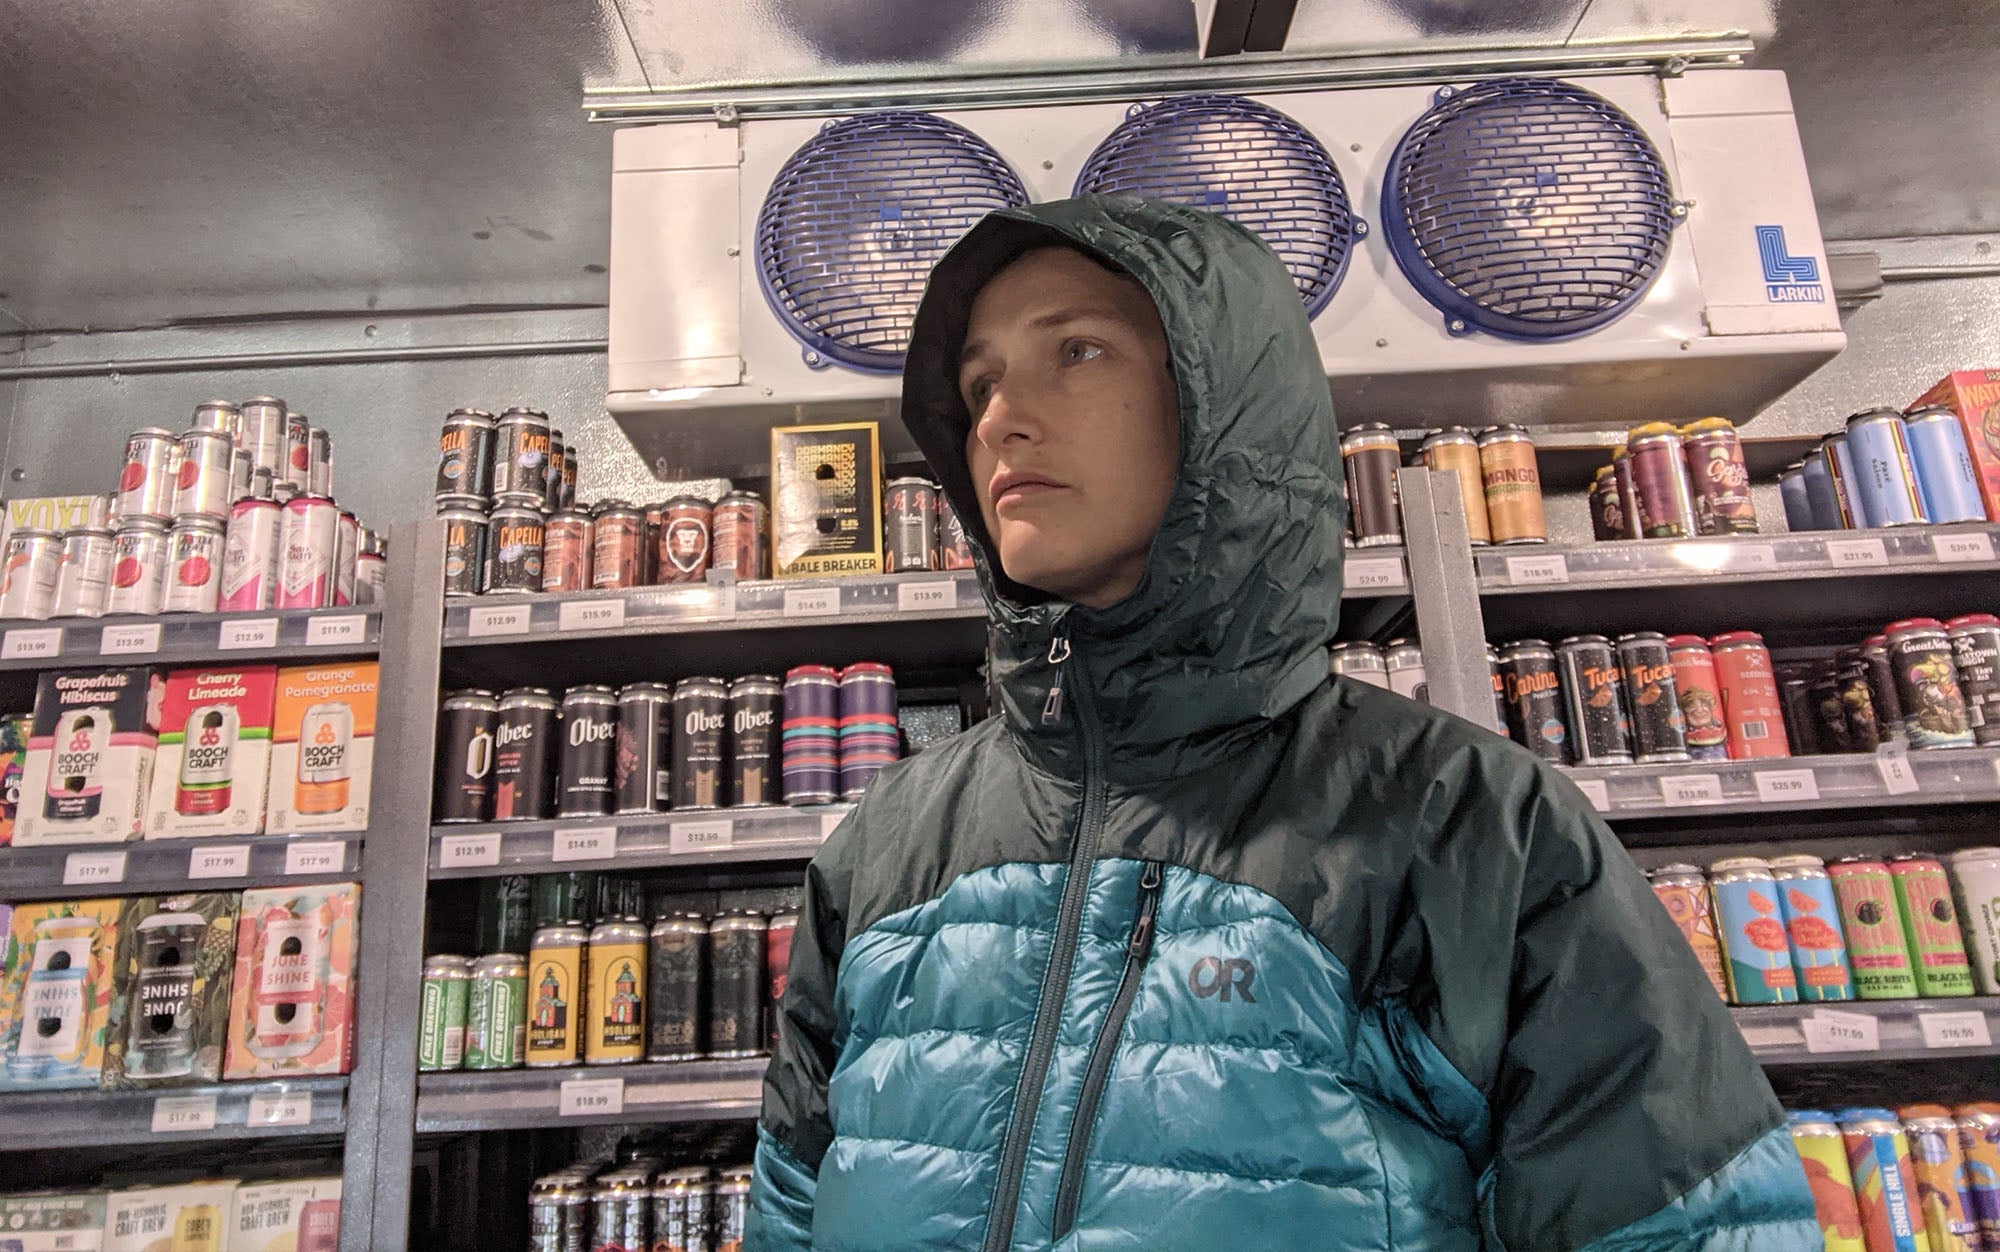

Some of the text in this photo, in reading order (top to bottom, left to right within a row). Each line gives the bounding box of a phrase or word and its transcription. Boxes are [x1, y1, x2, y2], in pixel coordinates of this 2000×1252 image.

[1769, 287, 1823, 301] LARKIN
[1486, 468, 1536, 486] MANGO
[500, 526, 543, 549] CAPELLA
[791, 558, 877, 574] BALE BREAKER
[321, 626, 350, 636] $11.99
[56, 673, 127, 690] Grapefruit
[196, 672, 243, 686] Cherry
[305, 669, 356, 682] Orange
[60, 689, 117, 704] Hibiscus
[188, 686, 247, 701] Limeade
[285, 683, 375, 698] Pomegranate
[685, 709, 725, 735] Obec
[734, 706, 775, 734] Obec
[496, 721, 533, 748] Obec
[570, 716, 615, 747] Obec
[57, 752, 99, 764] BOOCH
[189, 746, 229, 758] BOOCH
[305, 745, 345, 757] BOOCH
[57, 763, 95, 775] CRAFT
[189, 757, 225, 768] CRAFT
[305, 756, 342, 767] CRAFT
[204, 857, 235, 868] $17.99
[271, 954, 308, 968] JUNE
[266, 971, 311, 985] SHINE
[1188, 956, 1257, 1003] OR
[142, 983, 189, 1000] SHINE
[143, 1002, 184, 1017] JUNE
[1883, 1163, 1911, 1237] SINGLE HILL
